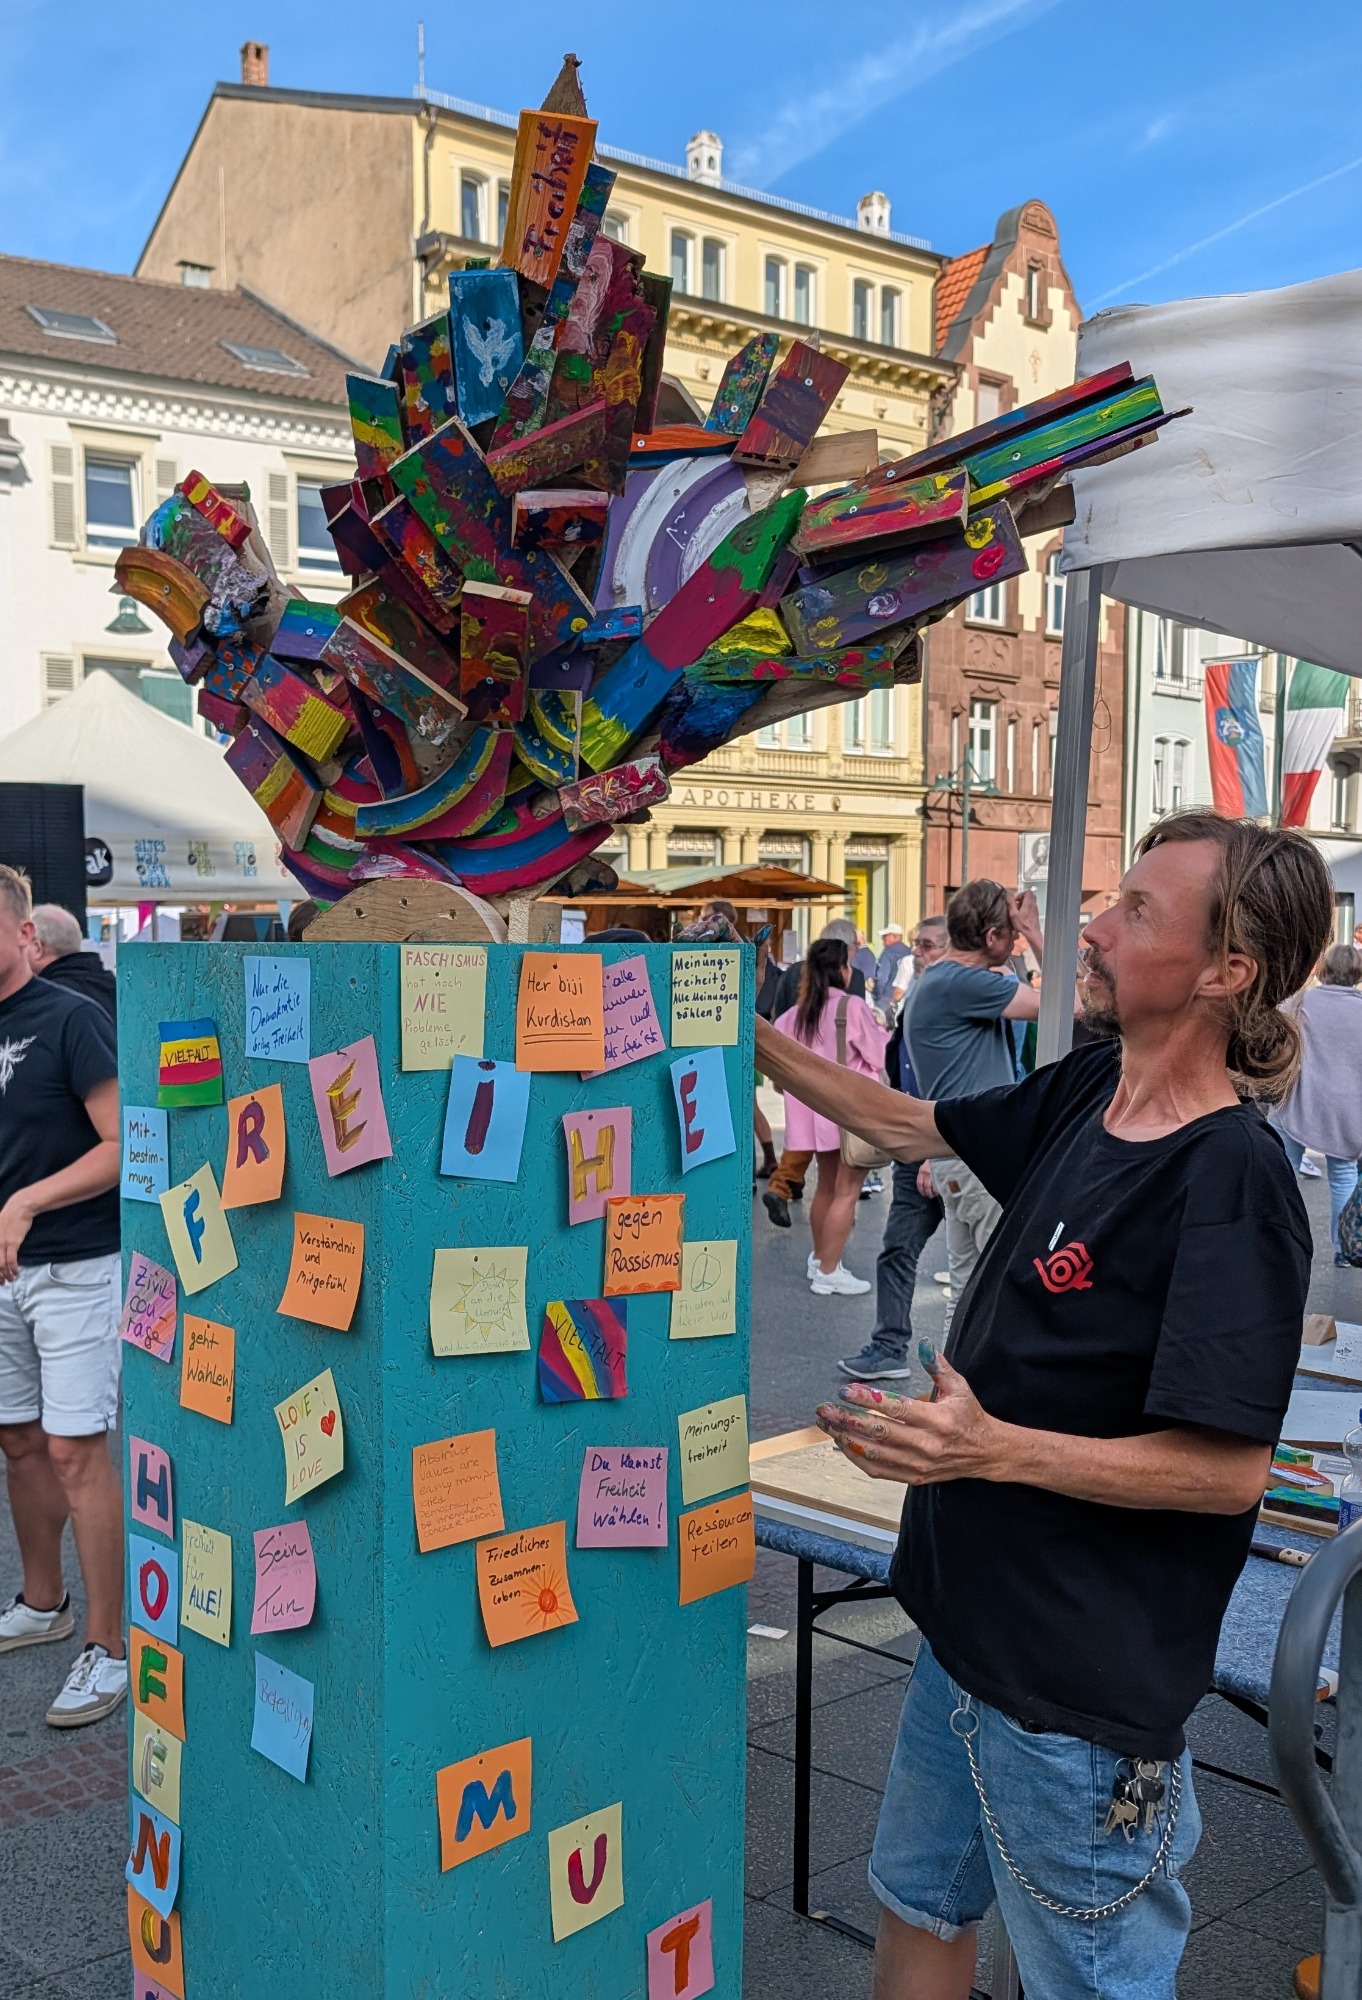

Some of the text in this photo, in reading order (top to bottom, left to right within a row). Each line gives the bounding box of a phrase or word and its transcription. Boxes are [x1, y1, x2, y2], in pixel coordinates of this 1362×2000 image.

[681, 788, 815, 811] APOTHEKE
[405, 951, 485, 968] FASCHISMUS
[673, 955, 735, 971] Meinungs-
[252, 960, 289, 998] Nur die
[406, 976, 462, 988] hat noch
[527, 972, 551, 993] Her
[413, 993, 447, 1013] NIE
[673, 991, 738, 1005] Alle Meinungen
[272, 1017, 304, 1049] Freiheit
[405, 1018, 452, 1034] Probleme
[165, 1045, 210, 1067] VIELFALT
[129, 1145, 164, 1164] bestim-
[183, 1189, 205, 1265] F
[236, 1101, 270, 1169] R
[325, 1059, 368, 1154] E
[570, 1125, 615, 1203] H
[680, 1070, 704, 1154] E
[129, 1173, 154, 1193] mung
[614, 1210, 663, 1240] gegen
[300, 1231, 356, 1254] Verständnis
[305, 1252, 320, 1266] und
[611, 1247, 680, 1275] Rassismus
[296, 1270, 347, 1295] Mitgefühl
[487, 1292, 503, 1303] die
[127, 1317, 166, 1350] rage
[188, 1328, 219, 1350] geht
[554, 1315, 625, 1371] VIELFALT
[278, 1392, 312, 1431] LOVE
[684, 1414, 740, 1441] Meinungs-
[295, 1434, 308, 1461] IS
[420, 1446, 471, 1468] Abstract
[688, 1439, 727, 1464] freiheit
[292, 1458, 322, 1491] LOVE
[420, 1459, 480, 1481] values are
[591, 1453, 611, 1471] Du
[137, 1453, 168, 1522] H
[420, 1481, 452, 1495] easily
[597, 1477, 646, 1499] Freiheit
[687, 1510, 752, 1542] Ressourcen
[184, 1523, 216, 1556] Freiheit
[486, 1537, 550, 1564] Friedliches
[691, 1536, 738, 1562] teilen
[259, 1535, 307, 1576] Sein
[185, 1553, 205, 1585] für
[139, 1559, 169, 1622] O
[189, 1583, 224, 1620] ALLE!
[493, 1589, 521, 1606] leben
[258, 1585, 304, 1625] Tun
[140, 1645, 168, 1704] F
[131, 1812, 171, 1891] N
[455, 1769, 700, 1996] M U T
[141, 1907, 172, 1965] U
